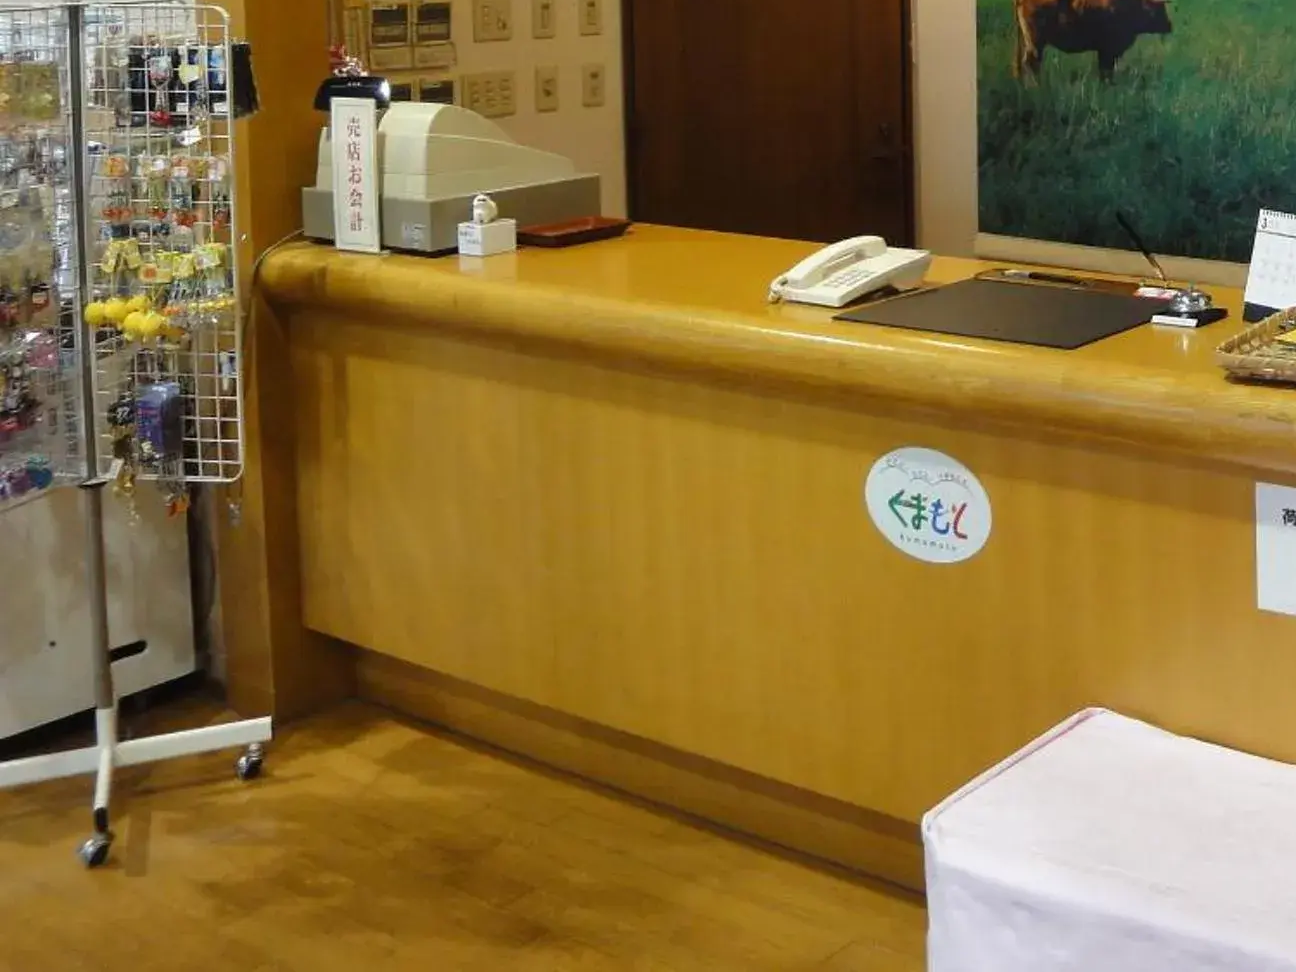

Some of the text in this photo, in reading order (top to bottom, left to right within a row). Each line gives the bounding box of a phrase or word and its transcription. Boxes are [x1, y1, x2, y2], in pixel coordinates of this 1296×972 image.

[347, 116, 363, 231] 売店お会計
